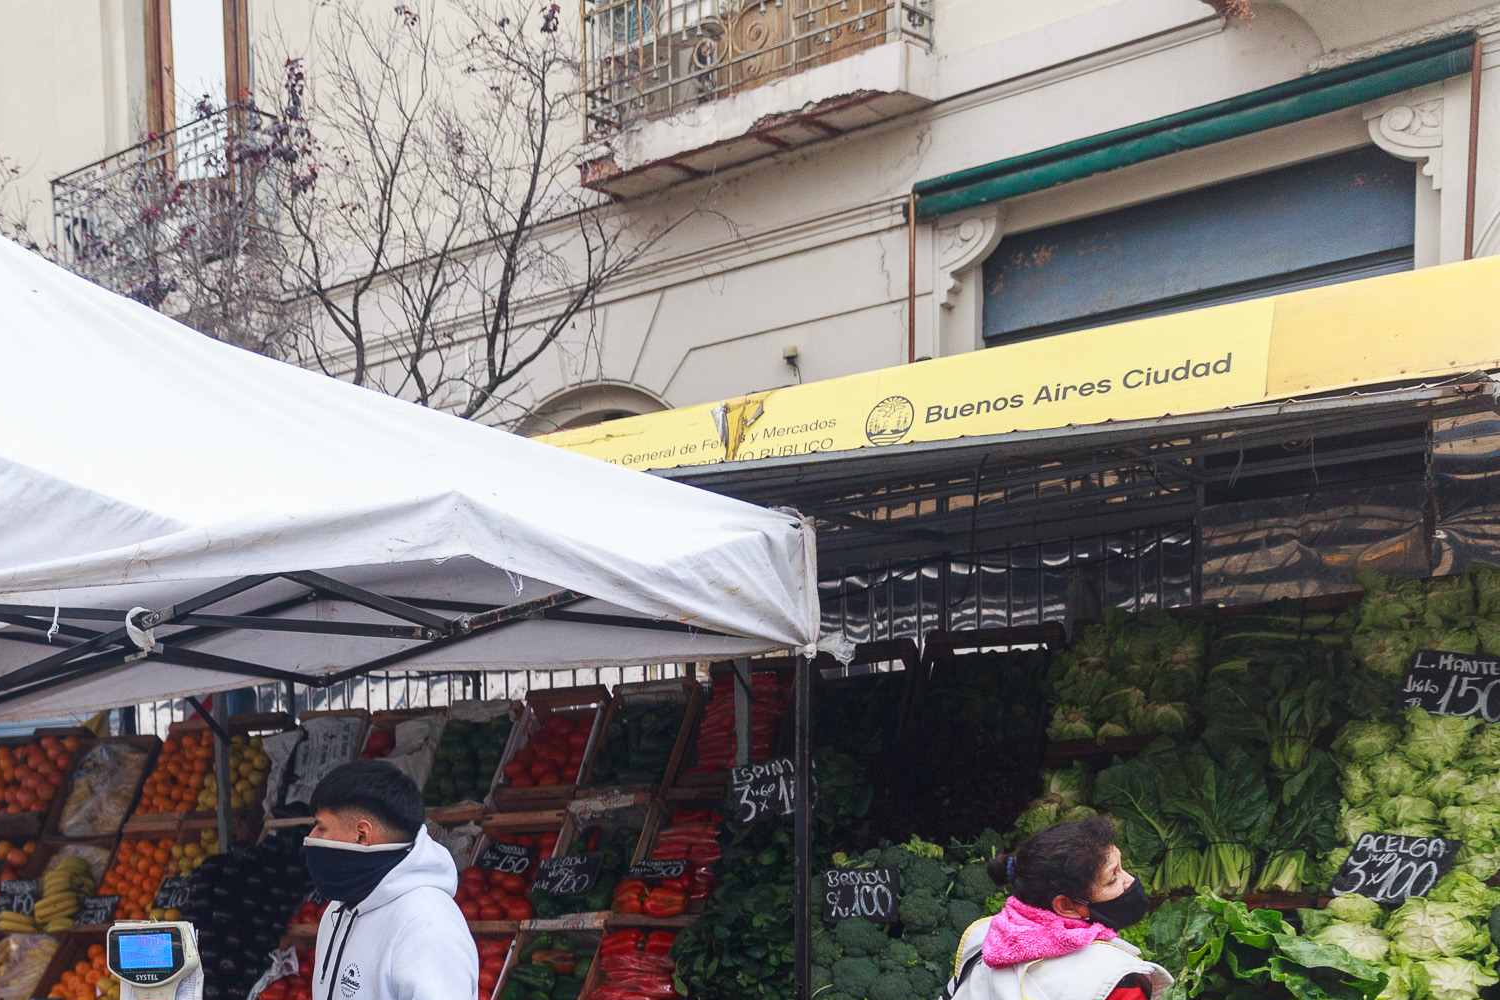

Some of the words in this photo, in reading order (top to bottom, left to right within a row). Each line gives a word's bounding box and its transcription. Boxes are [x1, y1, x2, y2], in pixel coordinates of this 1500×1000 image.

[925, 394, 1024, 424] Buenos
[1033, 377, 1112, 405] Aires
[1122, 352, 1232, 389] Ciudad
[621, 446, 676, 466] General
[680, 443, 697, 455] de
[750, 432, 759, 444] y
[763, 418, 837, 439] Mercados
[1356, 834, 1446, 858] ACELGA
[493, 855, 530, 874] 150
[549, 872, 589, 894] 150
[851, 884, 892, 917] 100
